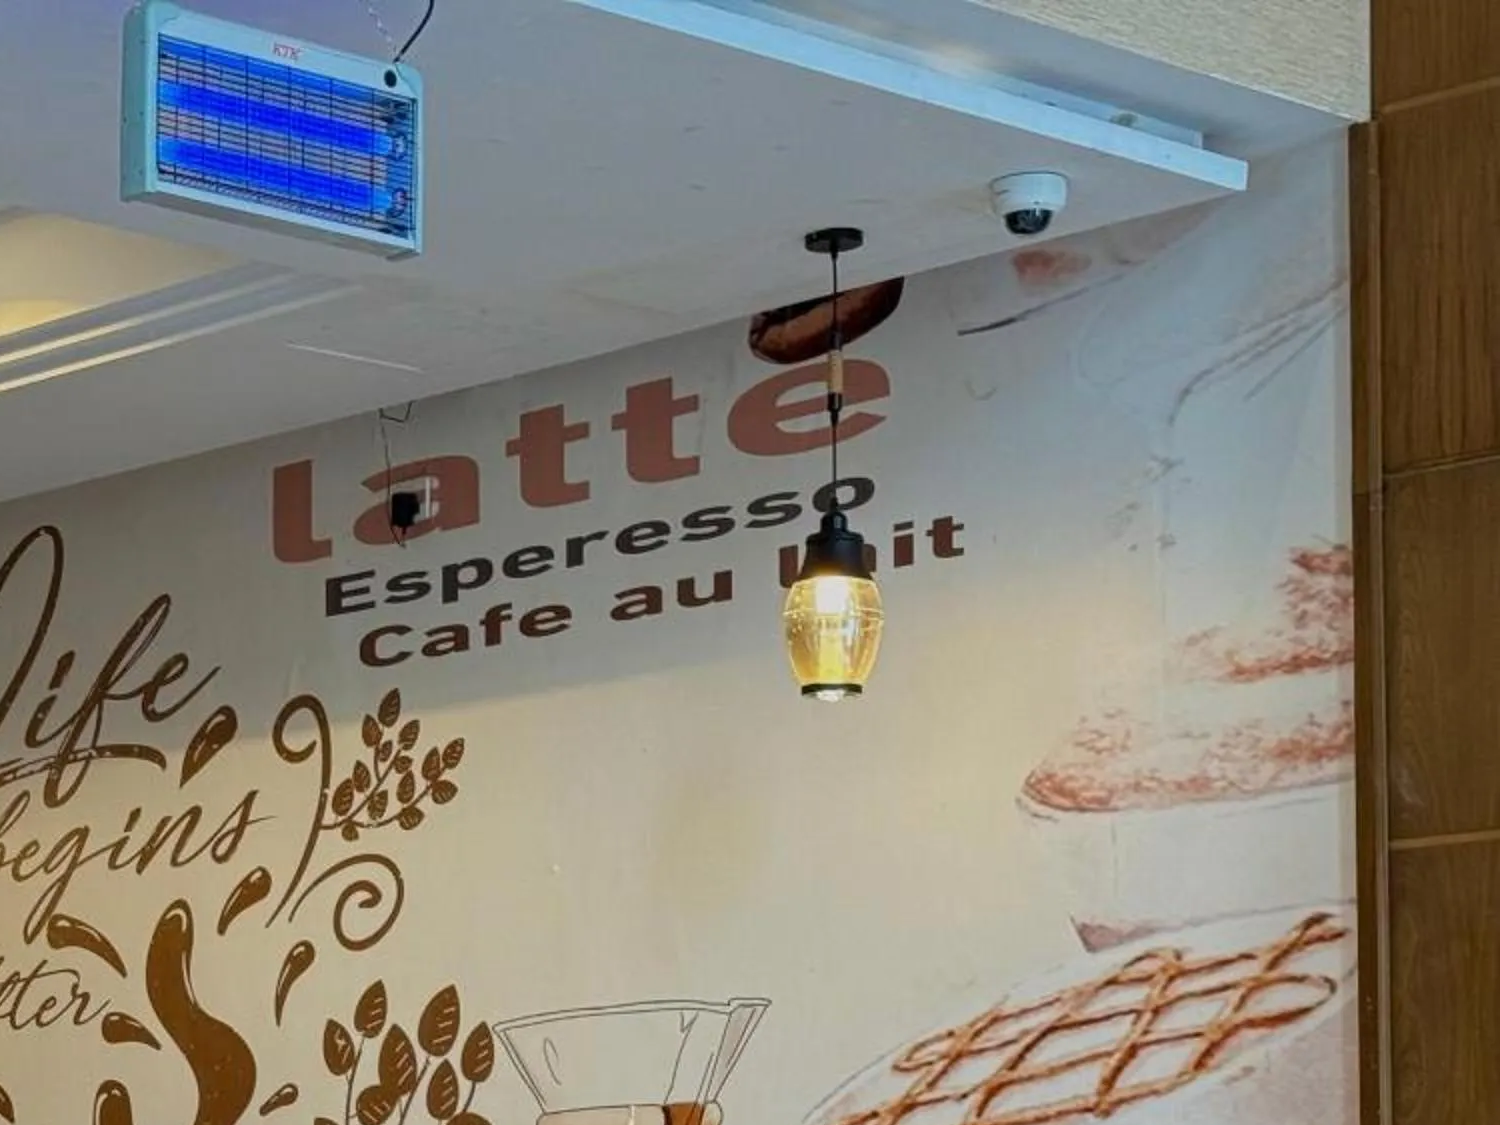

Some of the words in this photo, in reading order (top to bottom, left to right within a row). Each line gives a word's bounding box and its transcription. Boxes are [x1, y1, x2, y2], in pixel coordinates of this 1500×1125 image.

[271, 358, 891, 564] latte
[324, 476, 875, 617] Esperesso
[359, 600, 572, 668] Cafe
[610, 570, 733, 622] au
[779, 516, 965, 589] lit
